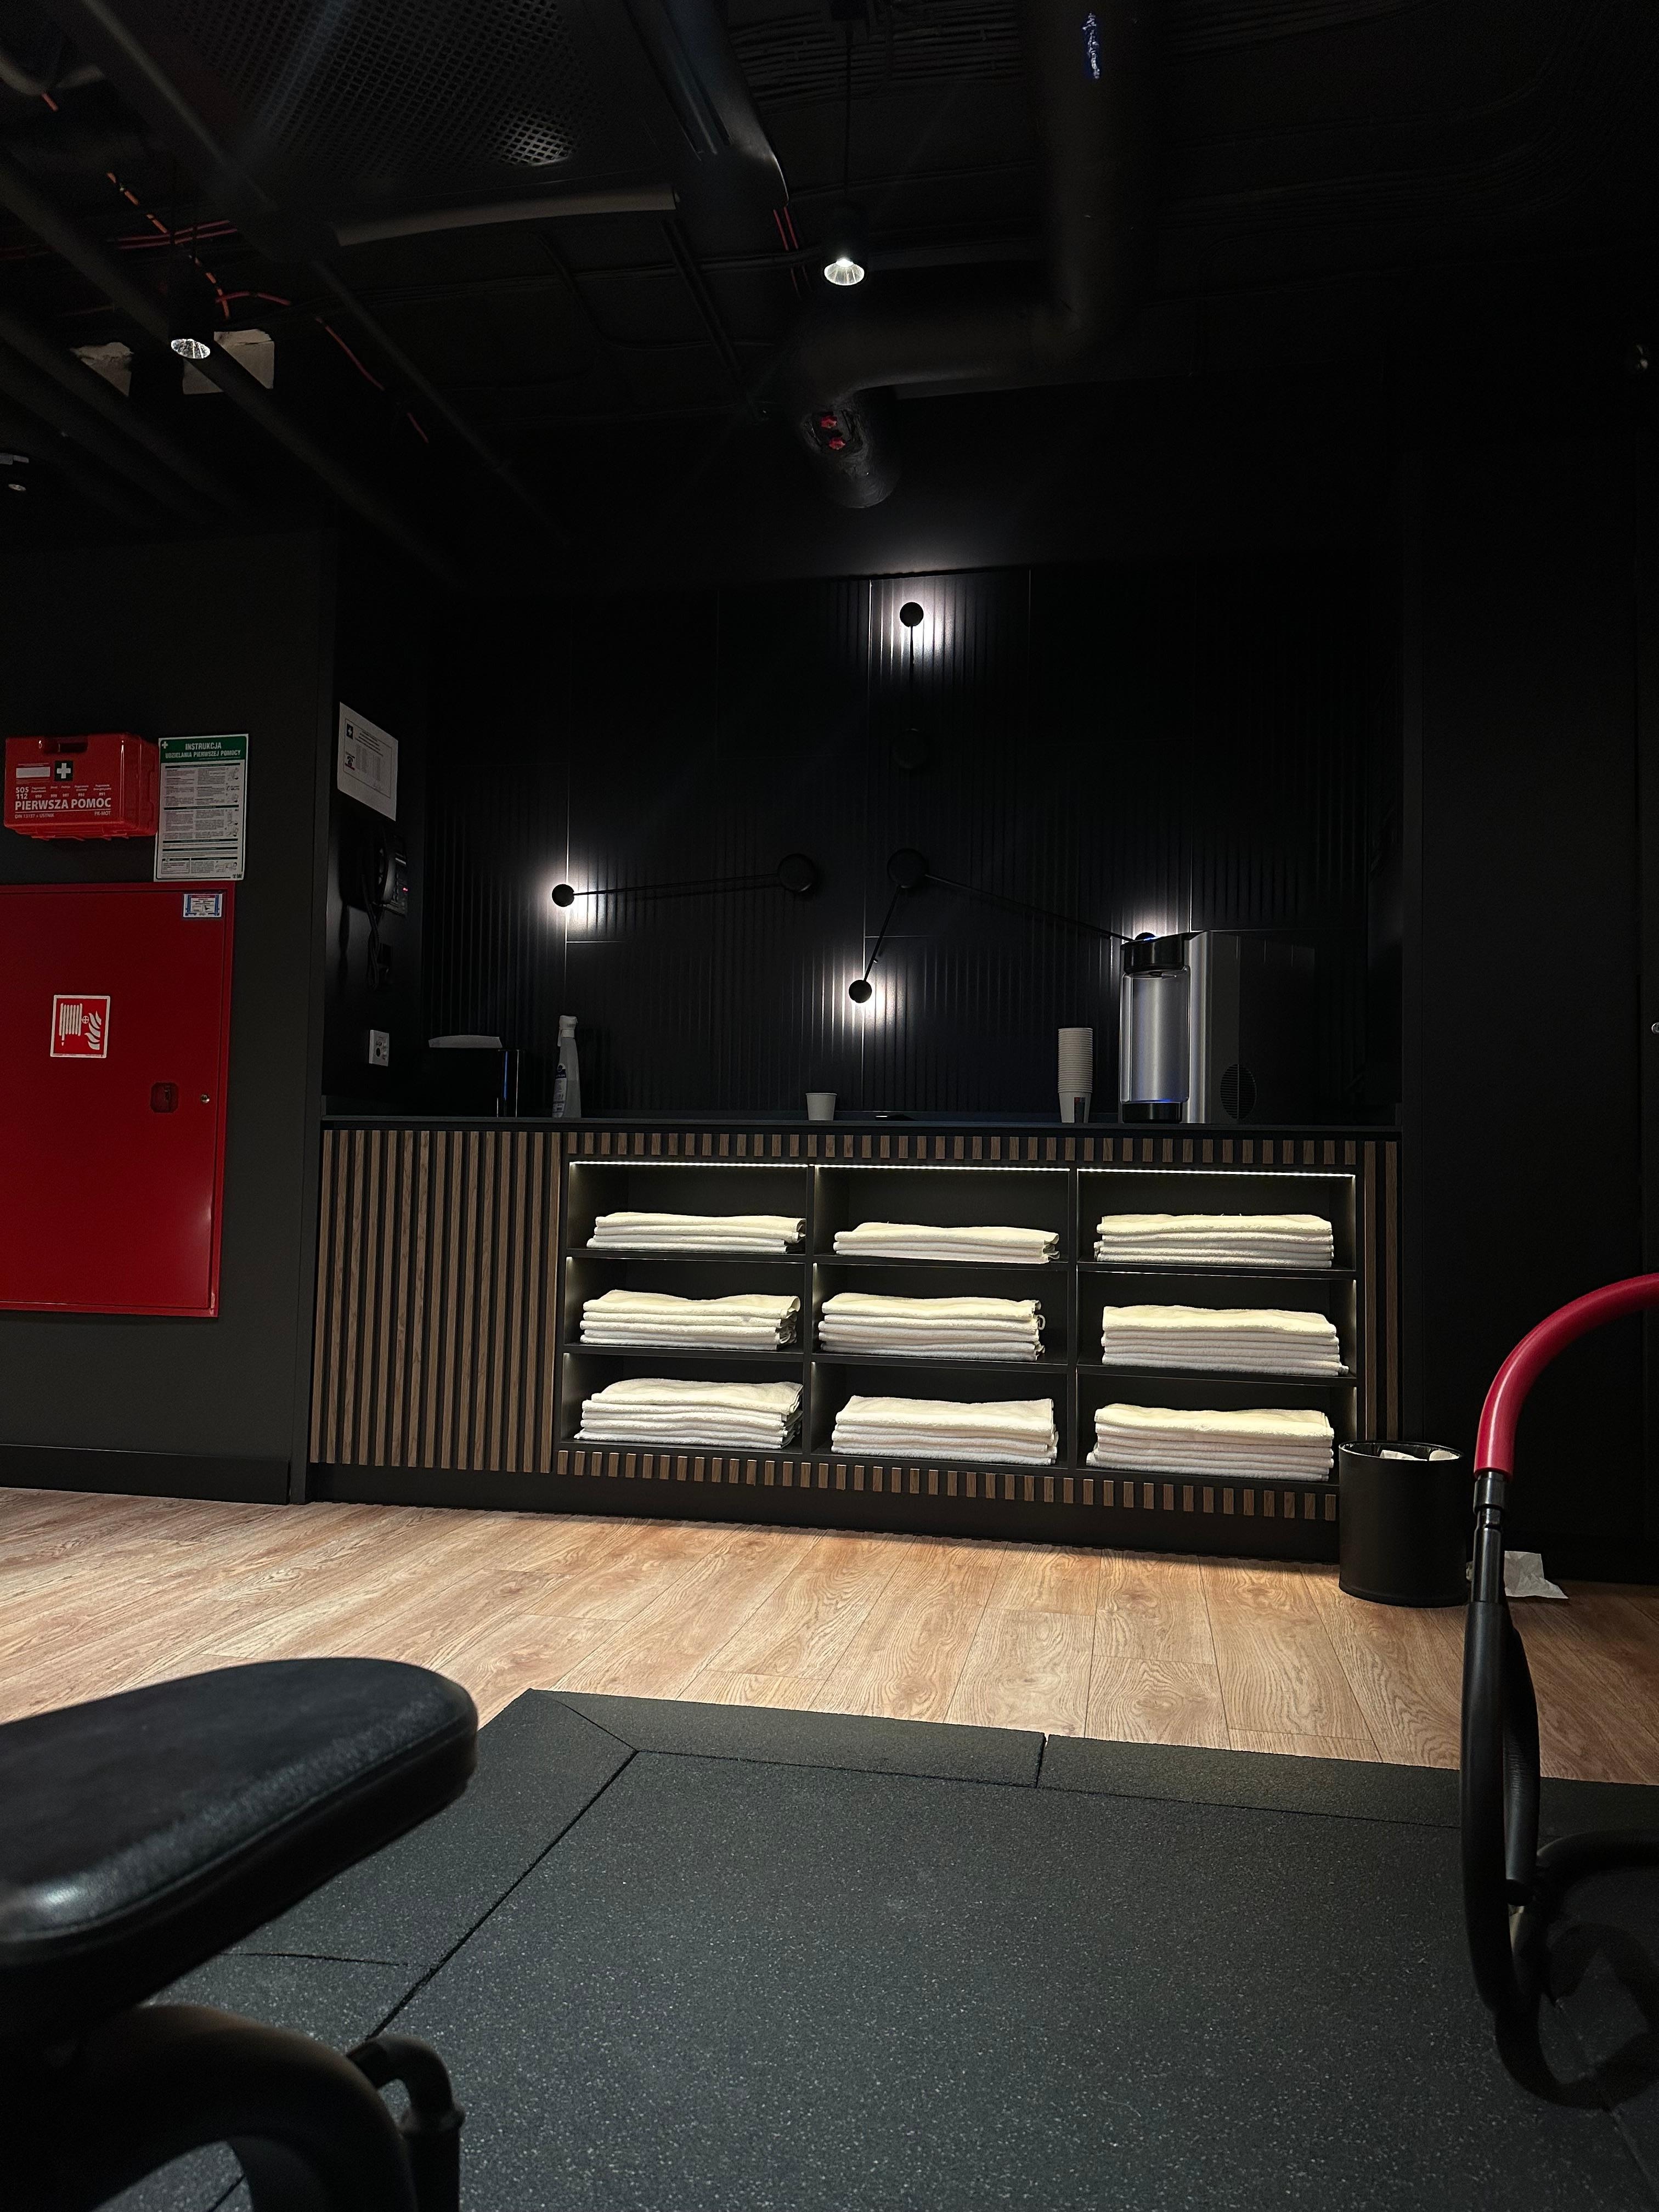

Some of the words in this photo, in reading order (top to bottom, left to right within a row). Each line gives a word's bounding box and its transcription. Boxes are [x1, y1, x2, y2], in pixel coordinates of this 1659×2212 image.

[185, 742, 222, 751] INSTRUKCJA
[15, 799, 69, 810] PIERWSZA
[71, 797, 111, 809] POMOC
